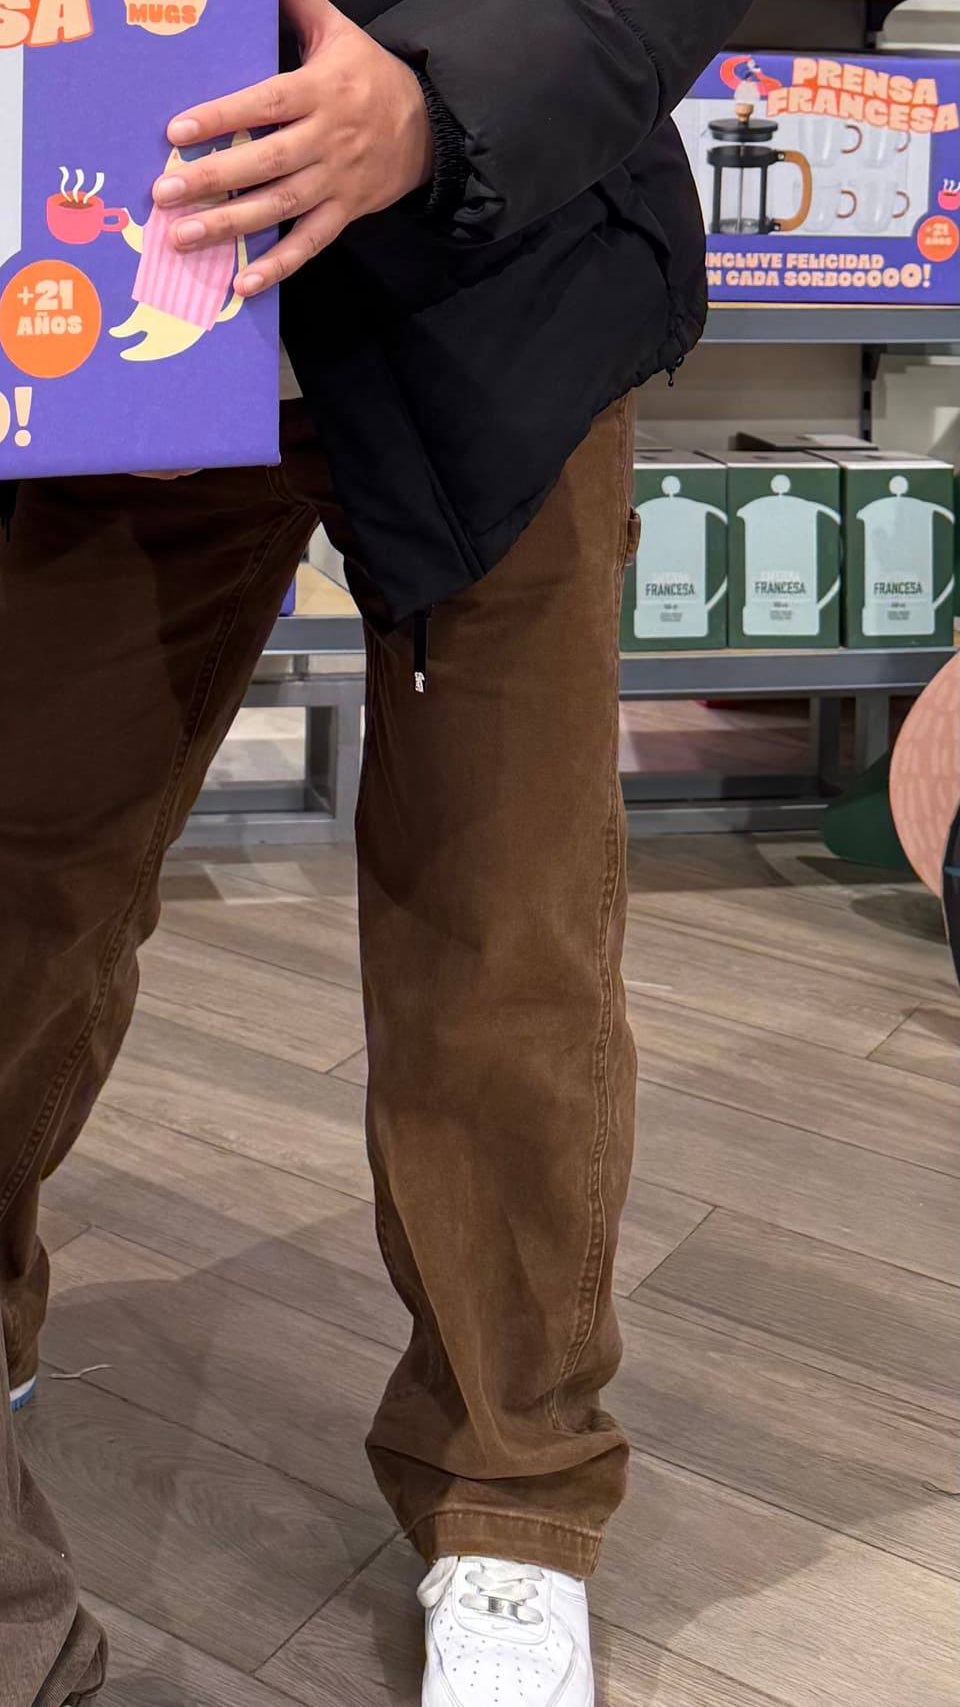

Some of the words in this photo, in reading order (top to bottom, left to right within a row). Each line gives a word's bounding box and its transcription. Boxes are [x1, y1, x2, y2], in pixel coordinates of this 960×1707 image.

[128, 2, 198, 24] MUGS
[792, 57, 939, 106] PRENSA
[766, 86, 959, 134] FRANCESA
[705, 252, 782, 268] NCLUYE
[786, 253, 884, 269] FELICIDAD
[707, 270, 722, 286] N
[725, 270, 779, 286] CADA
[783, 263, 931, 288] SORBOOOOO!
[17, 279, 74, 311] +21
[16, 313, 83, 335] AÑOS
[645, 582, 696, 596] FRANCESA
[754, 581, 807, 594] FRANCESA
[873, 582, 923, 595] FRANCESA
